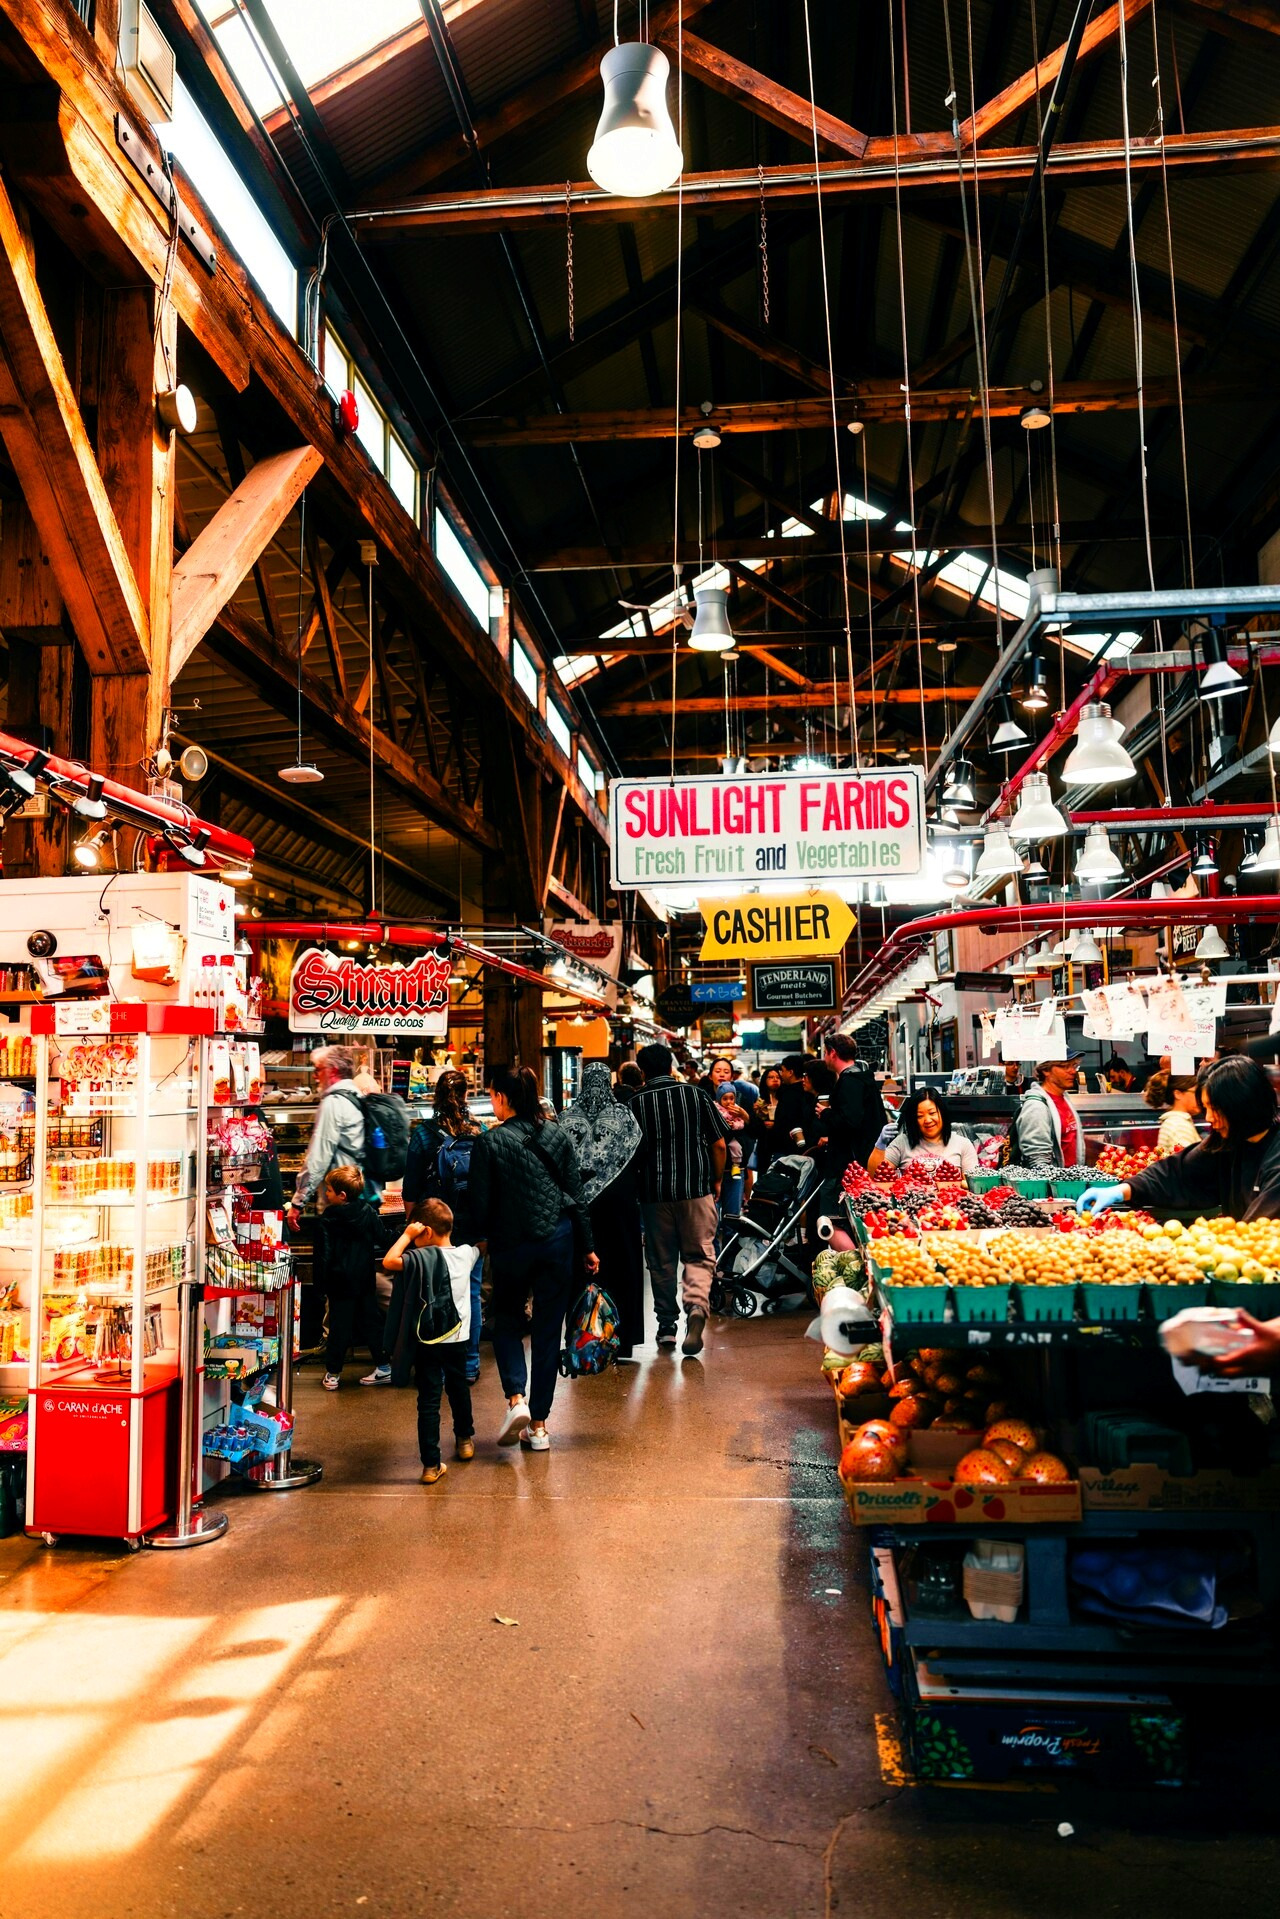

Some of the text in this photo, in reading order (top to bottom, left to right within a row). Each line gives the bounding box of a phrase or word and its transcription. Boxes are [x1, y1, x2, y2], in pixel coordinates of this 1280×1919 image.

[625, 779, 910, 838] SUNLIGHT FARMS
[635, 840, 901, 876] Fresh Fruit and Vegetables
[713, 904, 830, 945] CASHIER
[1182, 933, 1197, 953] BEEF
[298, 955, 451, 1012] Stuart's
[760, 970, 828, 986] TENDERLAND
[780, 981, 807, 989] meats
[766, 992, 794, 1000] Gourmet
[362, 1017, 391, 1027] BAKED
[58, 1401, 90, 1413] CARAN
[1085, 1479, 1140, 1496] Village
[857, 1491, 922, 1505] Driscoll's
[1001, 1733, 1101, 1756] Fresh Proprim
